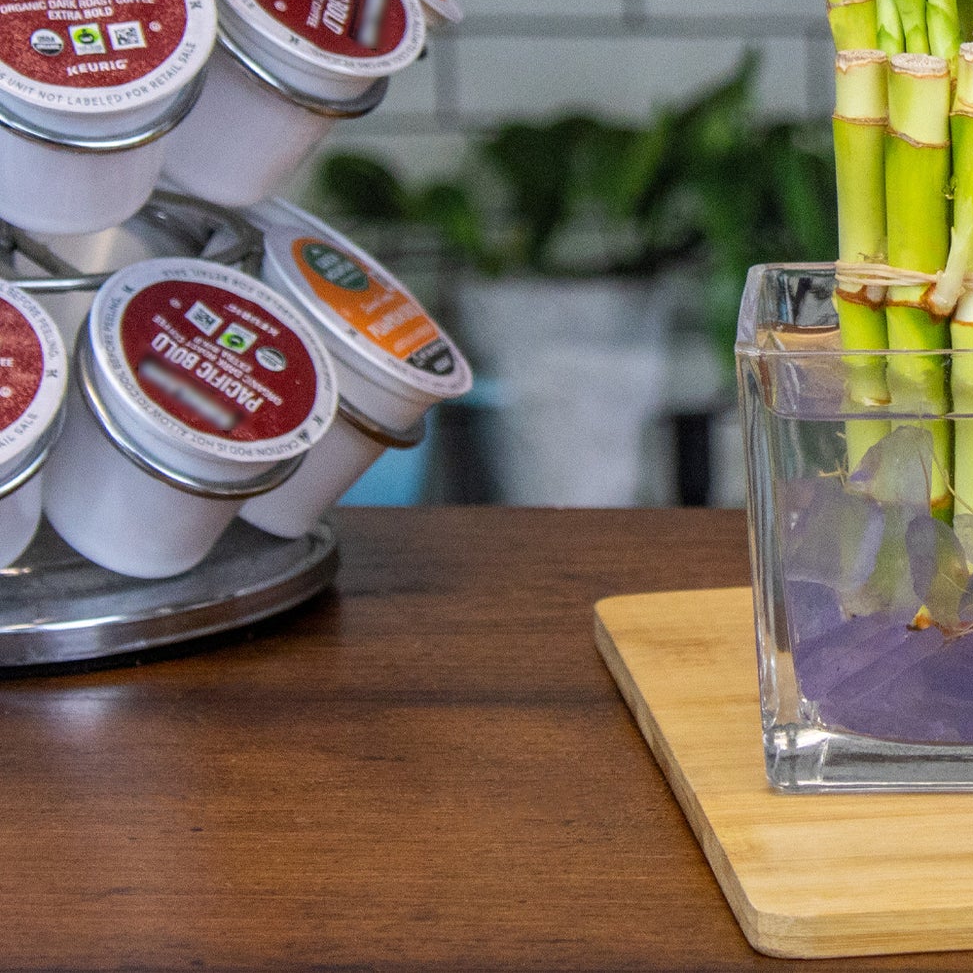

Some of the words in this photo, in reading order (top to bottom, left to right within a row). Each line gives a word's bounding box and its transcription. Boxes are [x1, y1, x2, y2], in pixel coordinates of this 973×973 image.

[0, 0, 47, 14] ORGANIC
[47, 9, 82, 21] EXTRA
[82, 6, 114, 19] BOLD
[7, 77, 35, 94] UNIT
[39, 90, 62, 102] NOT
[67, 93, 122, 106] LABELED
[125, 85, 149, 99] FOR
[149, 66, 182, 89] RETAIL
[178, 41, 196, 63] SALE
[66, 59, 128, 76] KEURIG
[151, 332, 200, 370] BOLD
[196, 360, 264, 413] PACIFIC
